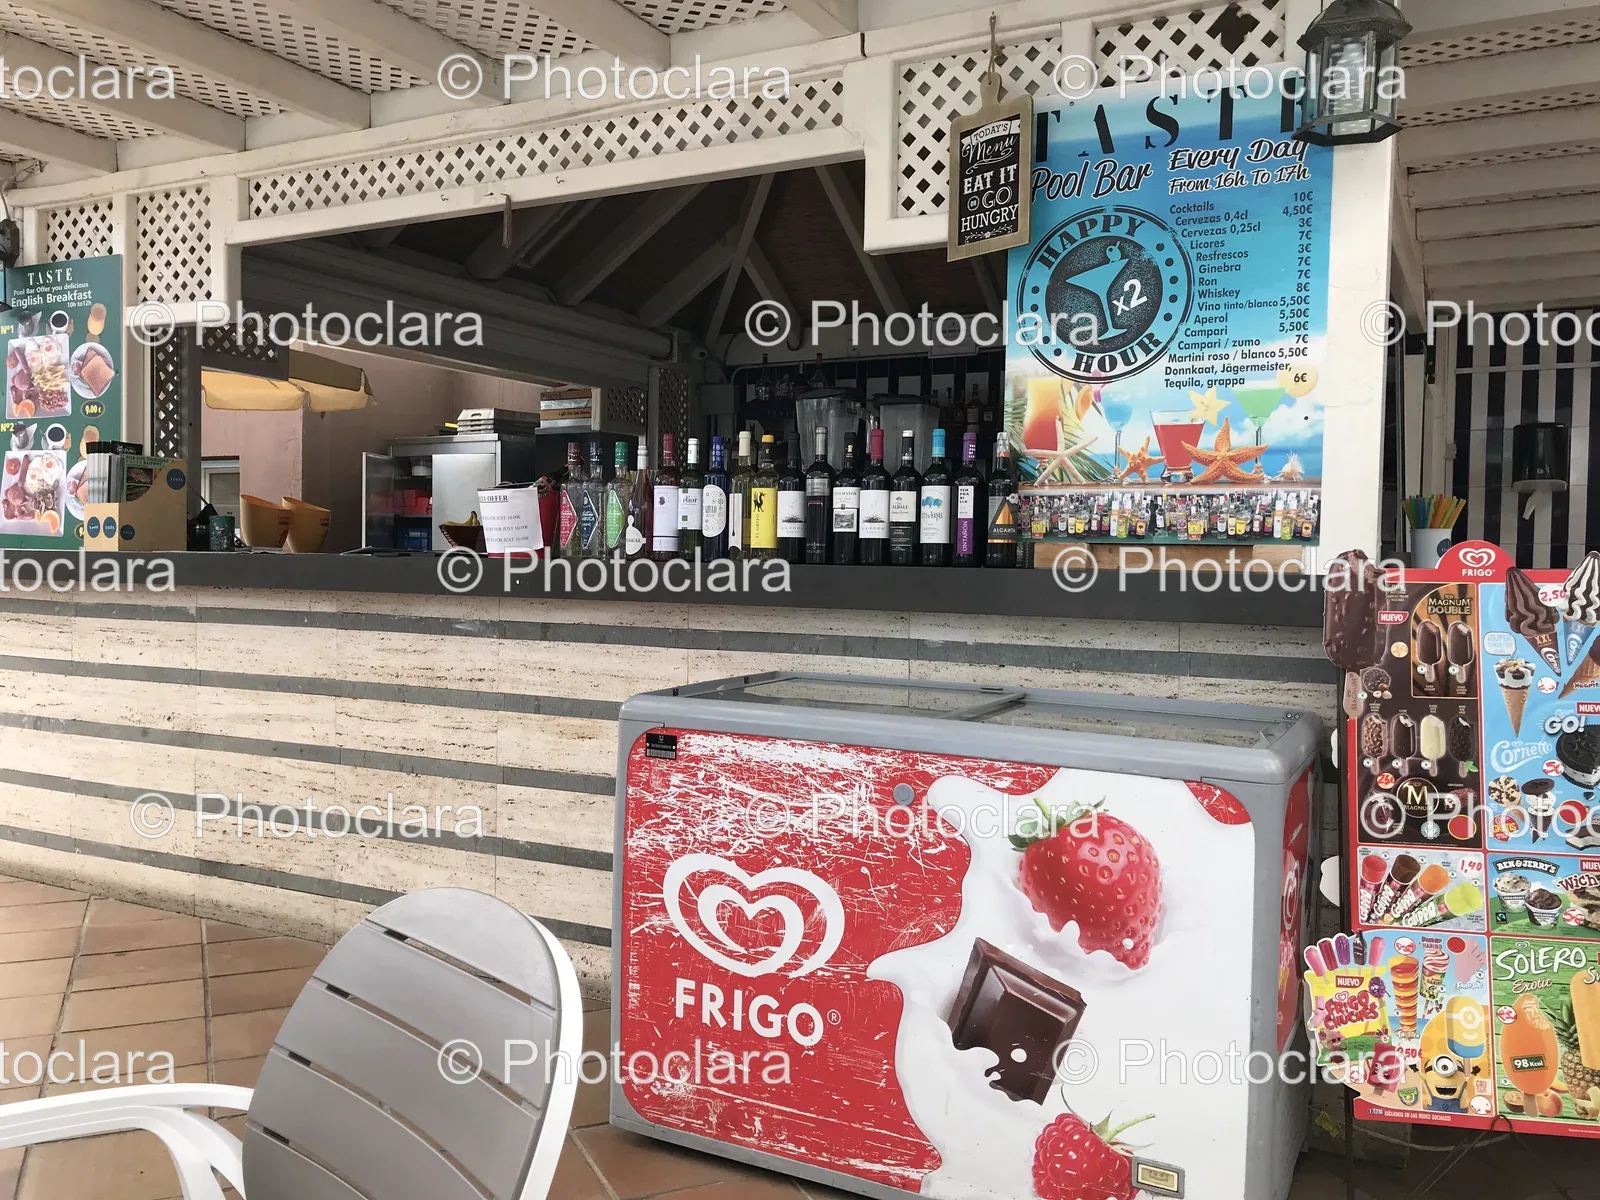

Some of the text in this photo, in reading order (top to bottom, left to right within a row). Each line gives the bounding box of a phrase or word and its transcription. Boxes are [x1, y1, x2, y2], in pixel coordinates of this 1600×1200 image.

[973, 123, 1009, 141] TODAY'S
[961, 135, 1019, 163] Menu
[1168, 138, 1310, 171] Every Day
[963, 163, 1018, 195] EAT IT
[1031, 159, 1154, 203] Pool Bar
[1168, 164, 1310, 195] From 16h To 17h
[982, 185, 1012, 209] GO
[1169, 191, 1313, 214] Cocktails 10€
[960, 203, 1019, 232] HUNGRY
[1175, 204, 1313, 226] Cervezas 0,4cl 4,50€
[1181, 217, 1312, 238] Cervezas 0,25cl 3€
[1037, 214, 1146, 271] HAPPY
[1190, 230, 1312, 249] Licores 7€
[1196, 243, 1311, 261] Resfrescos 3€
[1198, 256, 1311, 273] Ginebra 7€
[28, 268, 73, 286] TASTE
[64, 282, 89, 290] delicious
[1198, 269, 1311, 287] Ron 7€
[11, 290, 92, 309] English Breakfast
[1112, 279, 1148, 316] x2
[1197, 282, 1310, 299] Whiskey 8€
[1197, 295, 1310, 312] Vino tinto/blanco 5,50€
[1194, 308, 1309, 326] Aperol 5,50€
[1184, 321, 1309, 339] Campari 5,50€
[1177, 334, 1309, 351] Campari / zumo 7€
[1071, 332, 1163, 373] HOUR
[1168, 347, 1308, 363] Martini roso / blanco 5,50€
[1164, 362, 1292, 376] Donnkaat, Jägermeister,
[1164, 372, 1307, 389] Tequila, grappa 6€
[1462, 568, 1493, 577] FRIGO
[1428, 597, 1471, 607] MAGNUM
[1428, 605, 1471, 615] DOUBLE
[1380, 613, 1404, 622] NUEVO
[1535, 634, 1552, 645] XXL
[1544, 715, 1586, 733] GO!
[1490, 740, 1553, 773] Cornetto
[1407, 785, 1430, 805] M
[1402, 901, 1437, 927] Calippo
[1495, 946, 1588, 981] SOLERO
[1337, 978, 1360, 987] NUEVO
[1512, 977, 1552, 994] Exotic
[1325, 990, 1370, 1015] FRIGO
[1324, 1002, 1380, 1030] CHUCHES
[1513, 1058, 1529, 1068] 98
